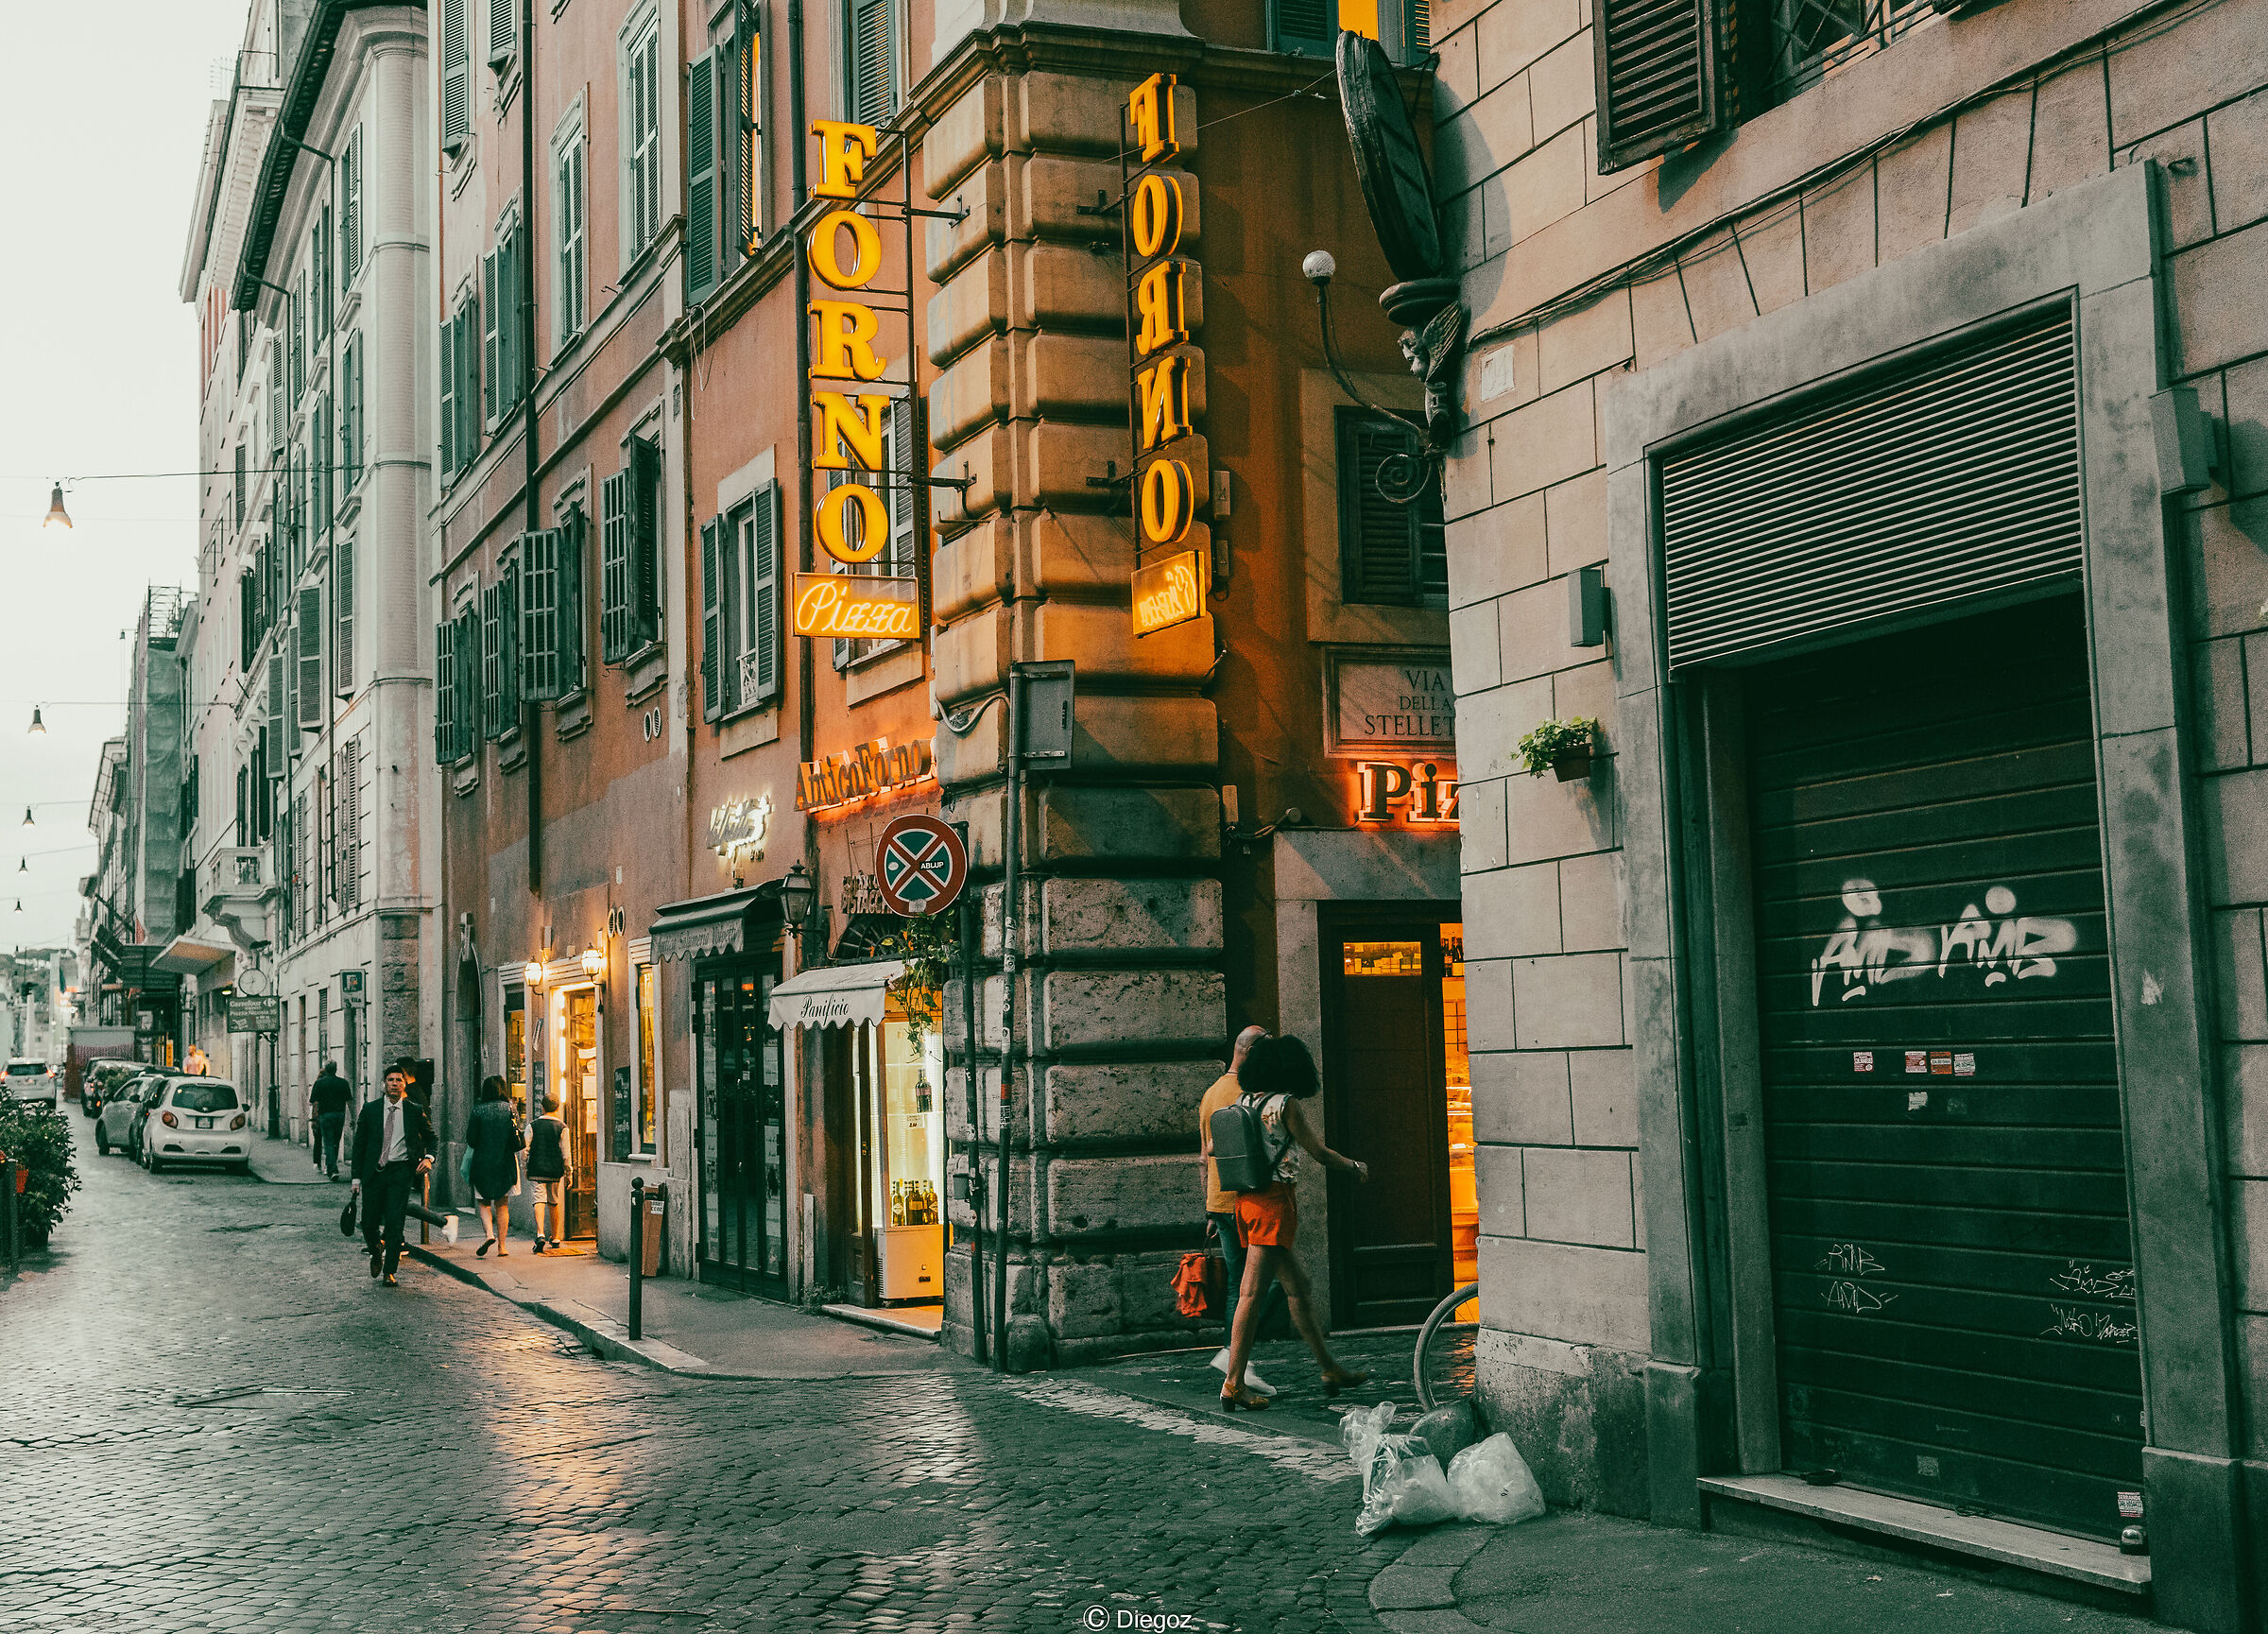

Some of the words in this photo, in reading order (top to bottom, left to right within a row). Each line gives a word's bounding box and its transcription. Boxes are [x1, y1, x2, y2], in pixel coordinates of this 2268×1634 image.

[807, 119, 891, 564] FORNO
[796, 579, 916, 635] Pizza
[1405, 669, 1446, 692] VIA
[1400, 696, 1454, 711] DELLA
[800, 993, 849, 1026] Panificio
